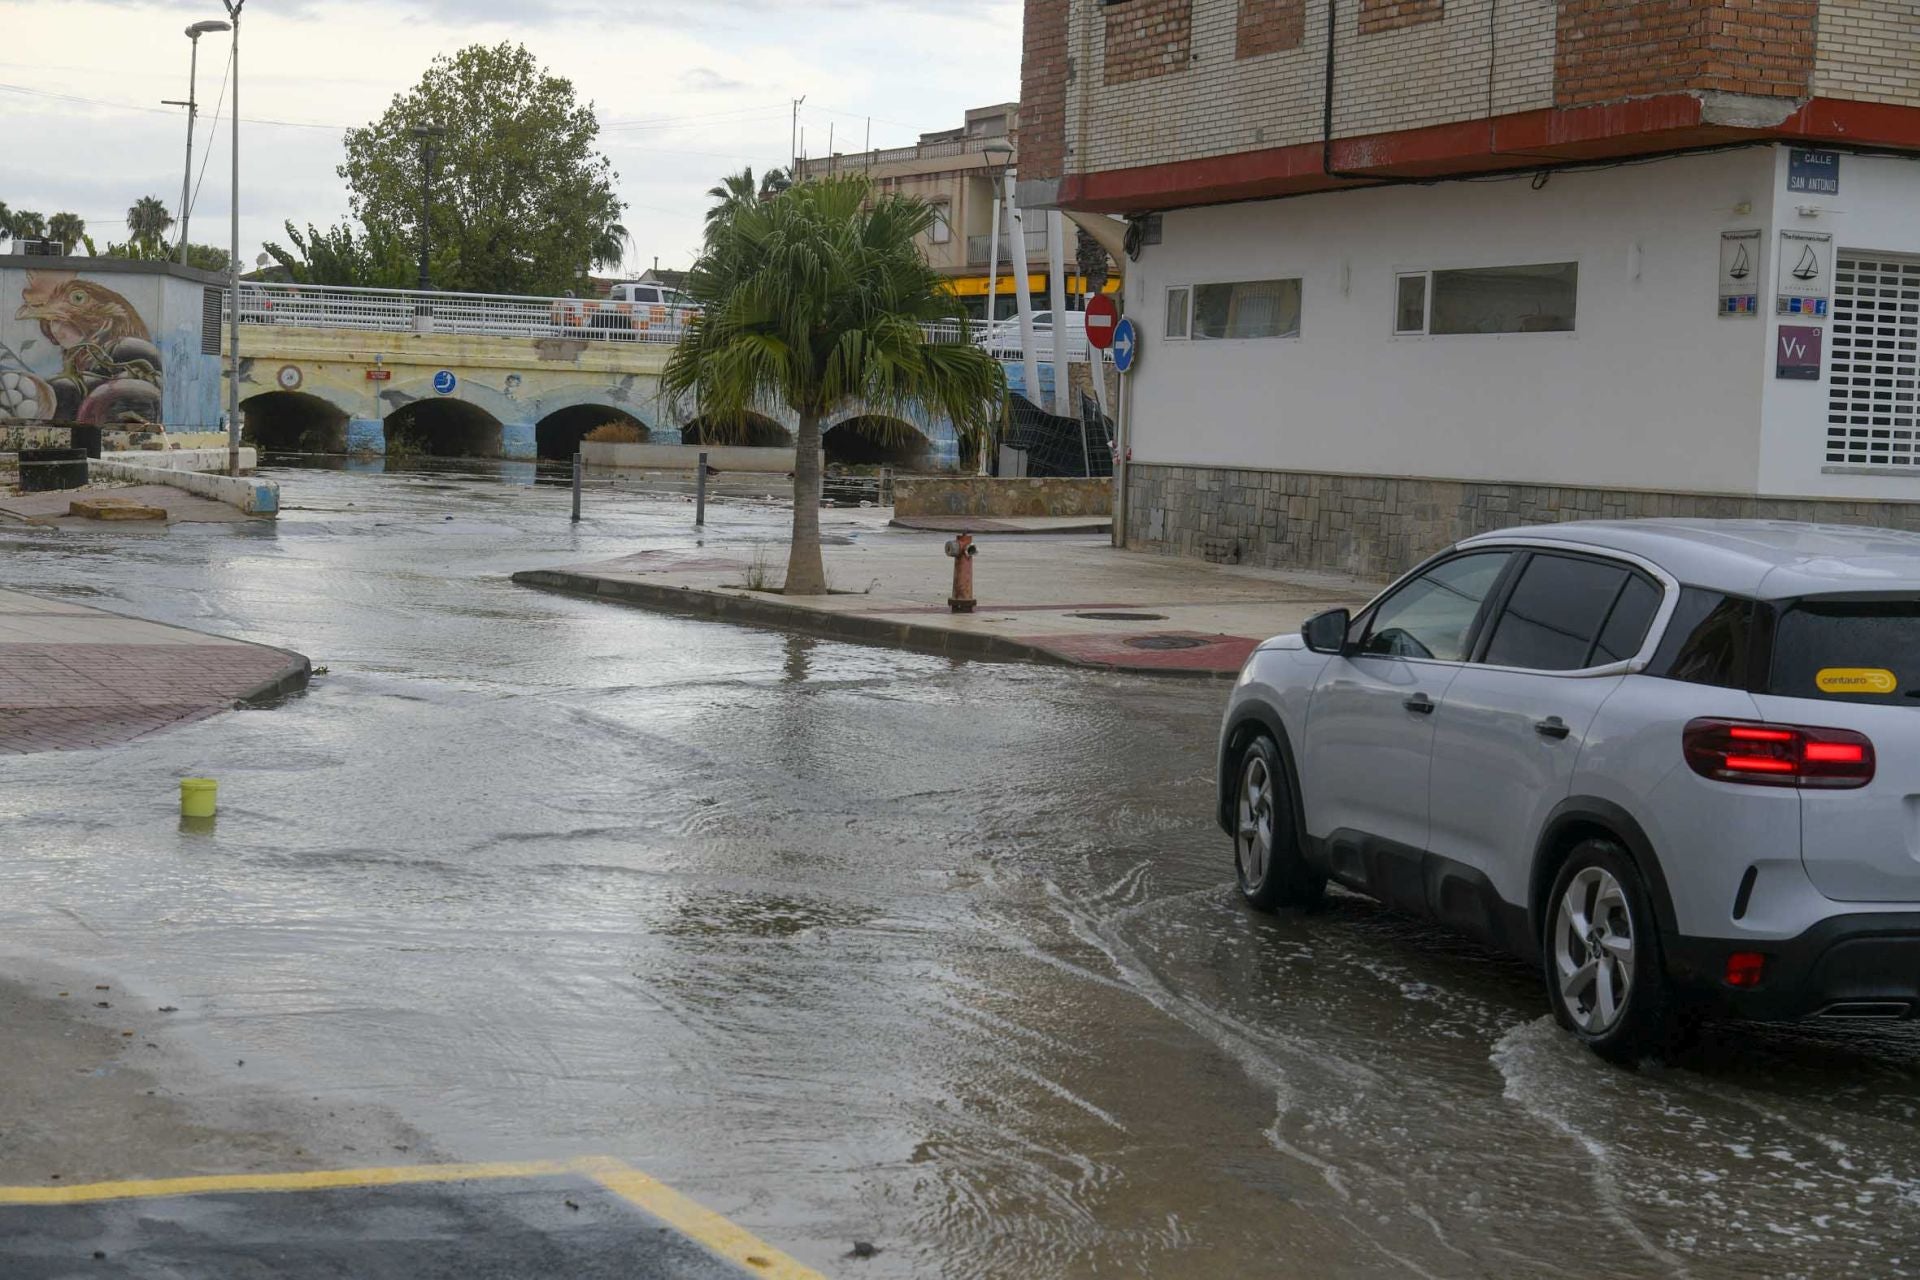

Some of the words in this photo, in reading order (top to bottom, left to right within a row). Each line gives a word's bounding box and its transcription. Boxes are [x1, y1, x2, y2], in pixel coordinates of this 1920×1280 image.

[1804, 153, 1832, 165] CALLE
[1791, 176, 1805, 189] SAN
[1808, 177, 1836, 192] ANTONIO
[1782, 335, 1806, 359] Vv
[1822, 676, 1867, 685] centauro
